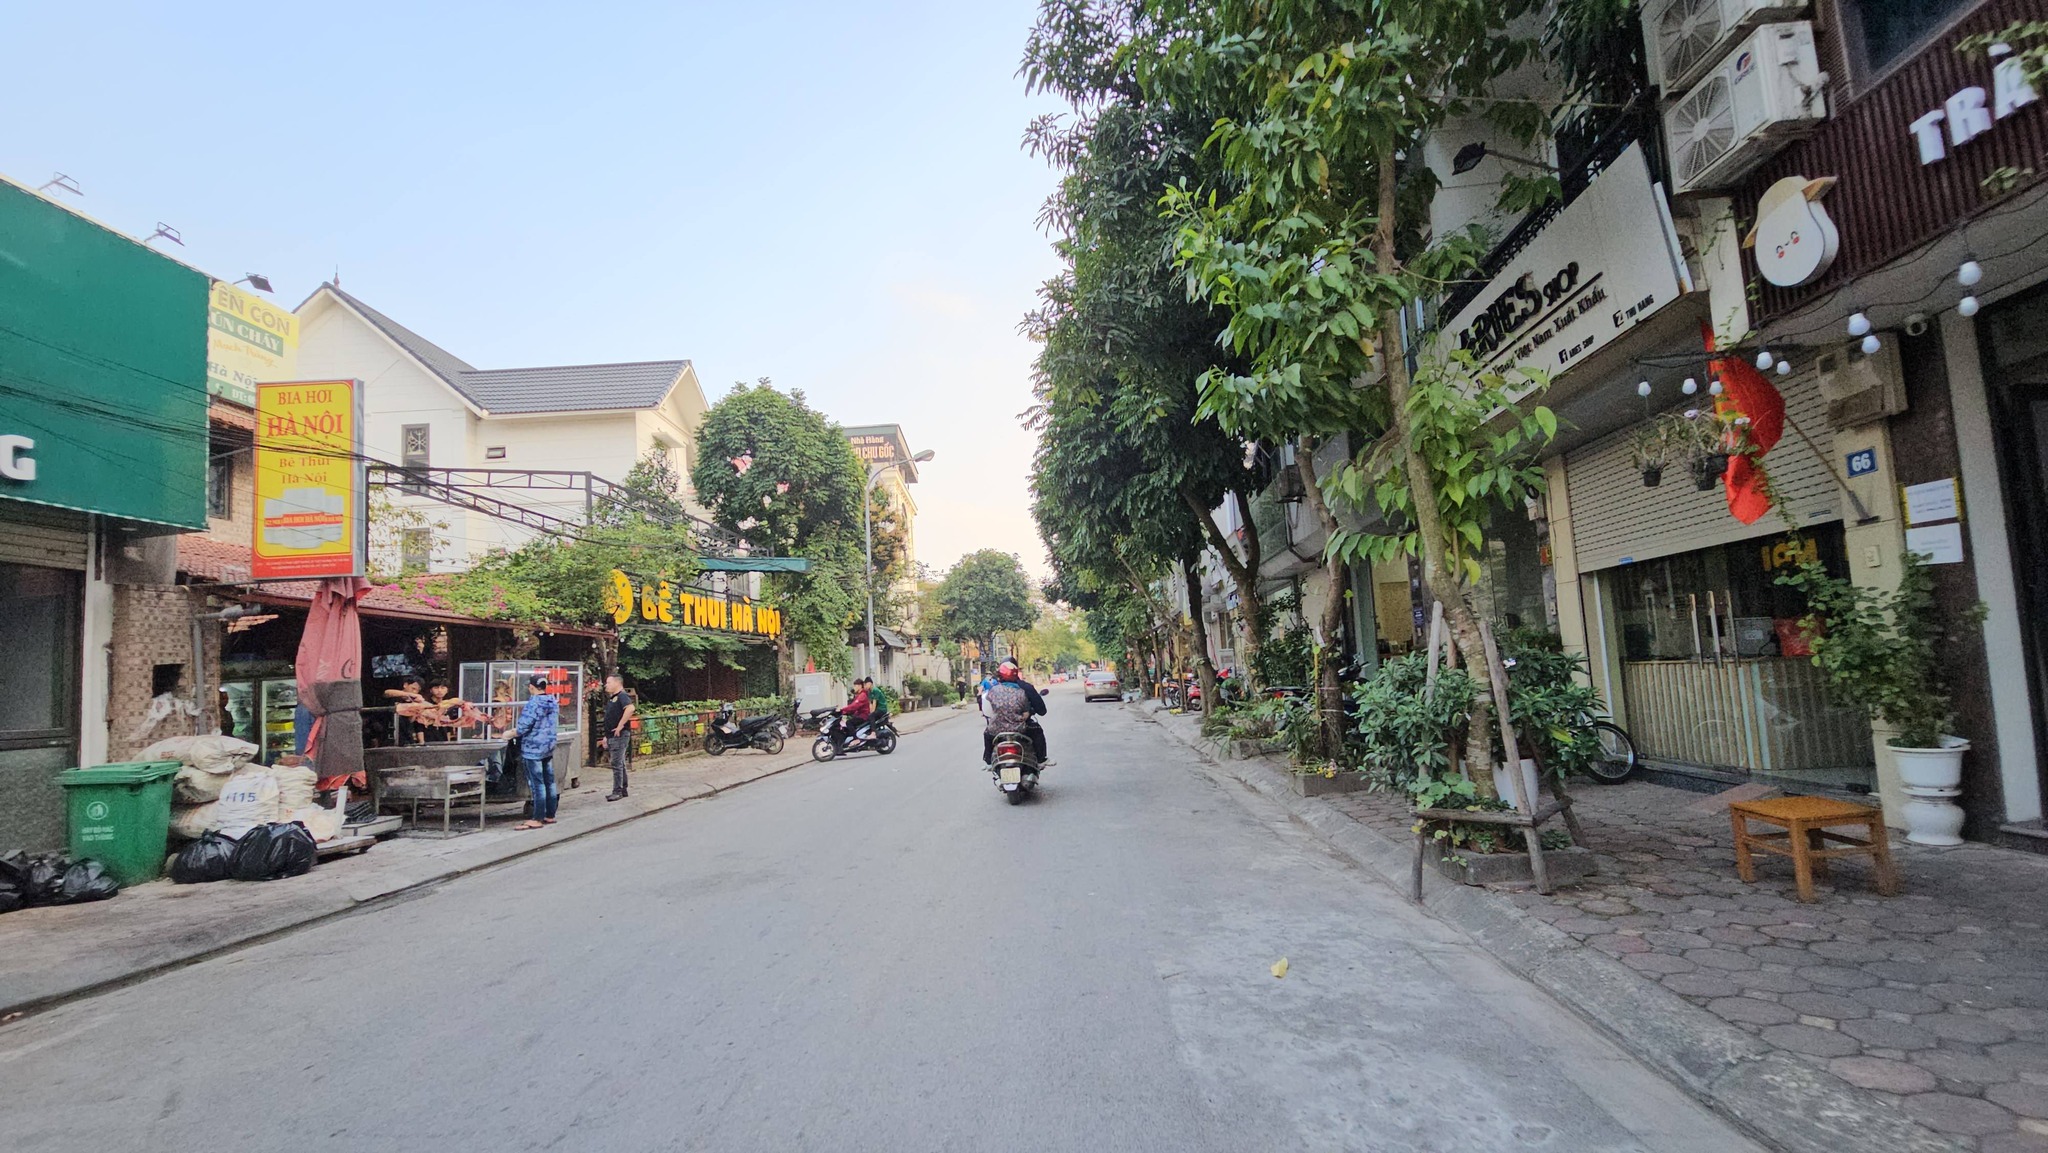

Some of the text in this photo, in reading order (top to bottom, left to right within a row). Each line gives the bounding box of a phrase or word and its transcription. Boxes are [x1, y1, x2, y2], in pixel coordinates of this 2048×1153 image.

[250, 305, 291, 337] CON
[1531, 328, 1555, 349] Nam
[208, 361, 229, 378] Hà
[278, 391, 302, 405] BIA
[267, 410, 343, 439] HÀ NỘI
[1852, 453, 1872, 472] 66
[680, 593, 727, 630] THUI
[731, 595, 754, 633] HÀ
[756, 604, 781, 641] NỘI
